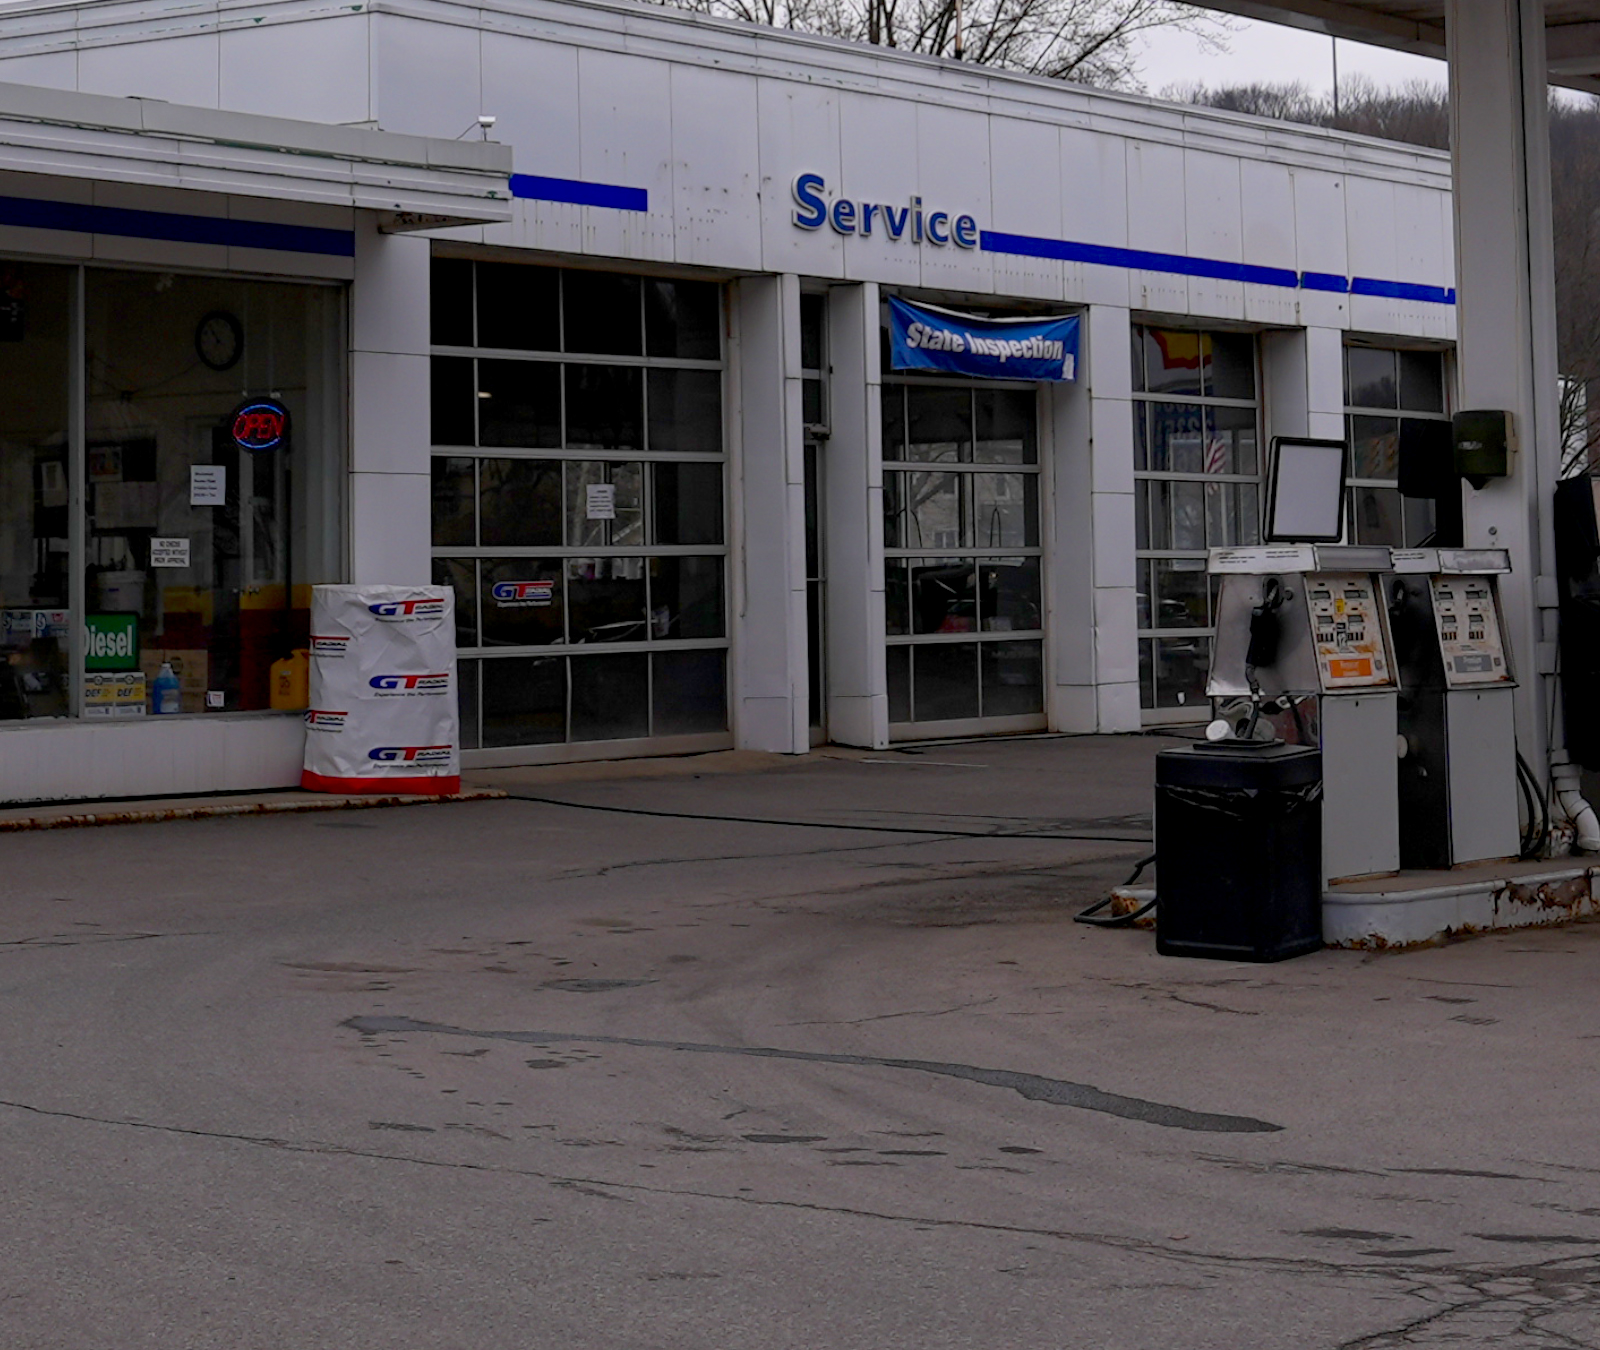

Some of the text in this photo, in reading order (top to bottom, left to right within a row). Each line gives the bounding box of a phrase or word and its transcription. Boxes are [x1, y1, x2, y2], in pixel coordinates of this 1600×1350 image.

[792, 173, 977, 249] Service
[906, 321, 1064, 363] State Inspection
[232, 413, 286, 439] OPEN
